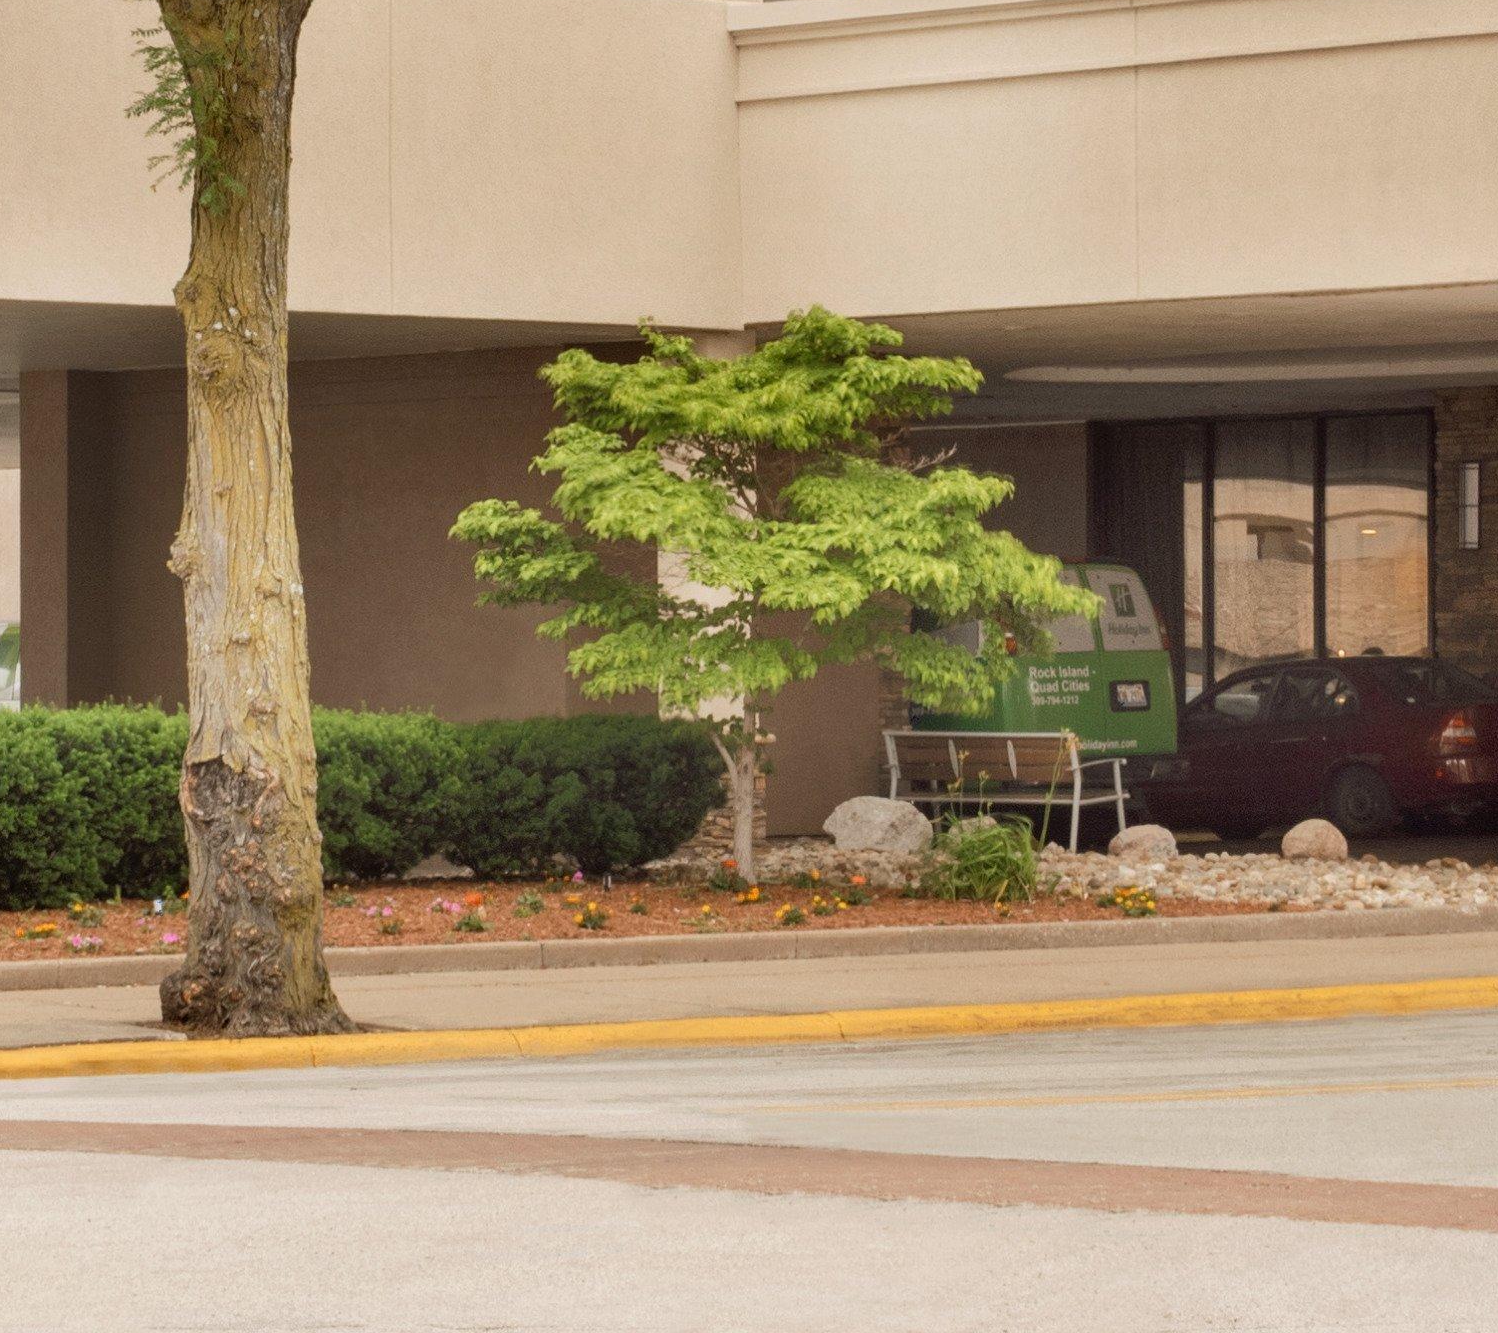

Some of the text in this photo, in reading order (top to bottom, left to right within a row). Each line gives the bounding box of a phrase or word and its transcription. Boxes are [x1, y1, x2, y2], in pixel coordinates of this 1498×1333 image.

[1029, 666, 1056, 679] Rock
[1059, 665, 1089, 677] Island
[1030, 679, 1090, 693] Quad Cities
